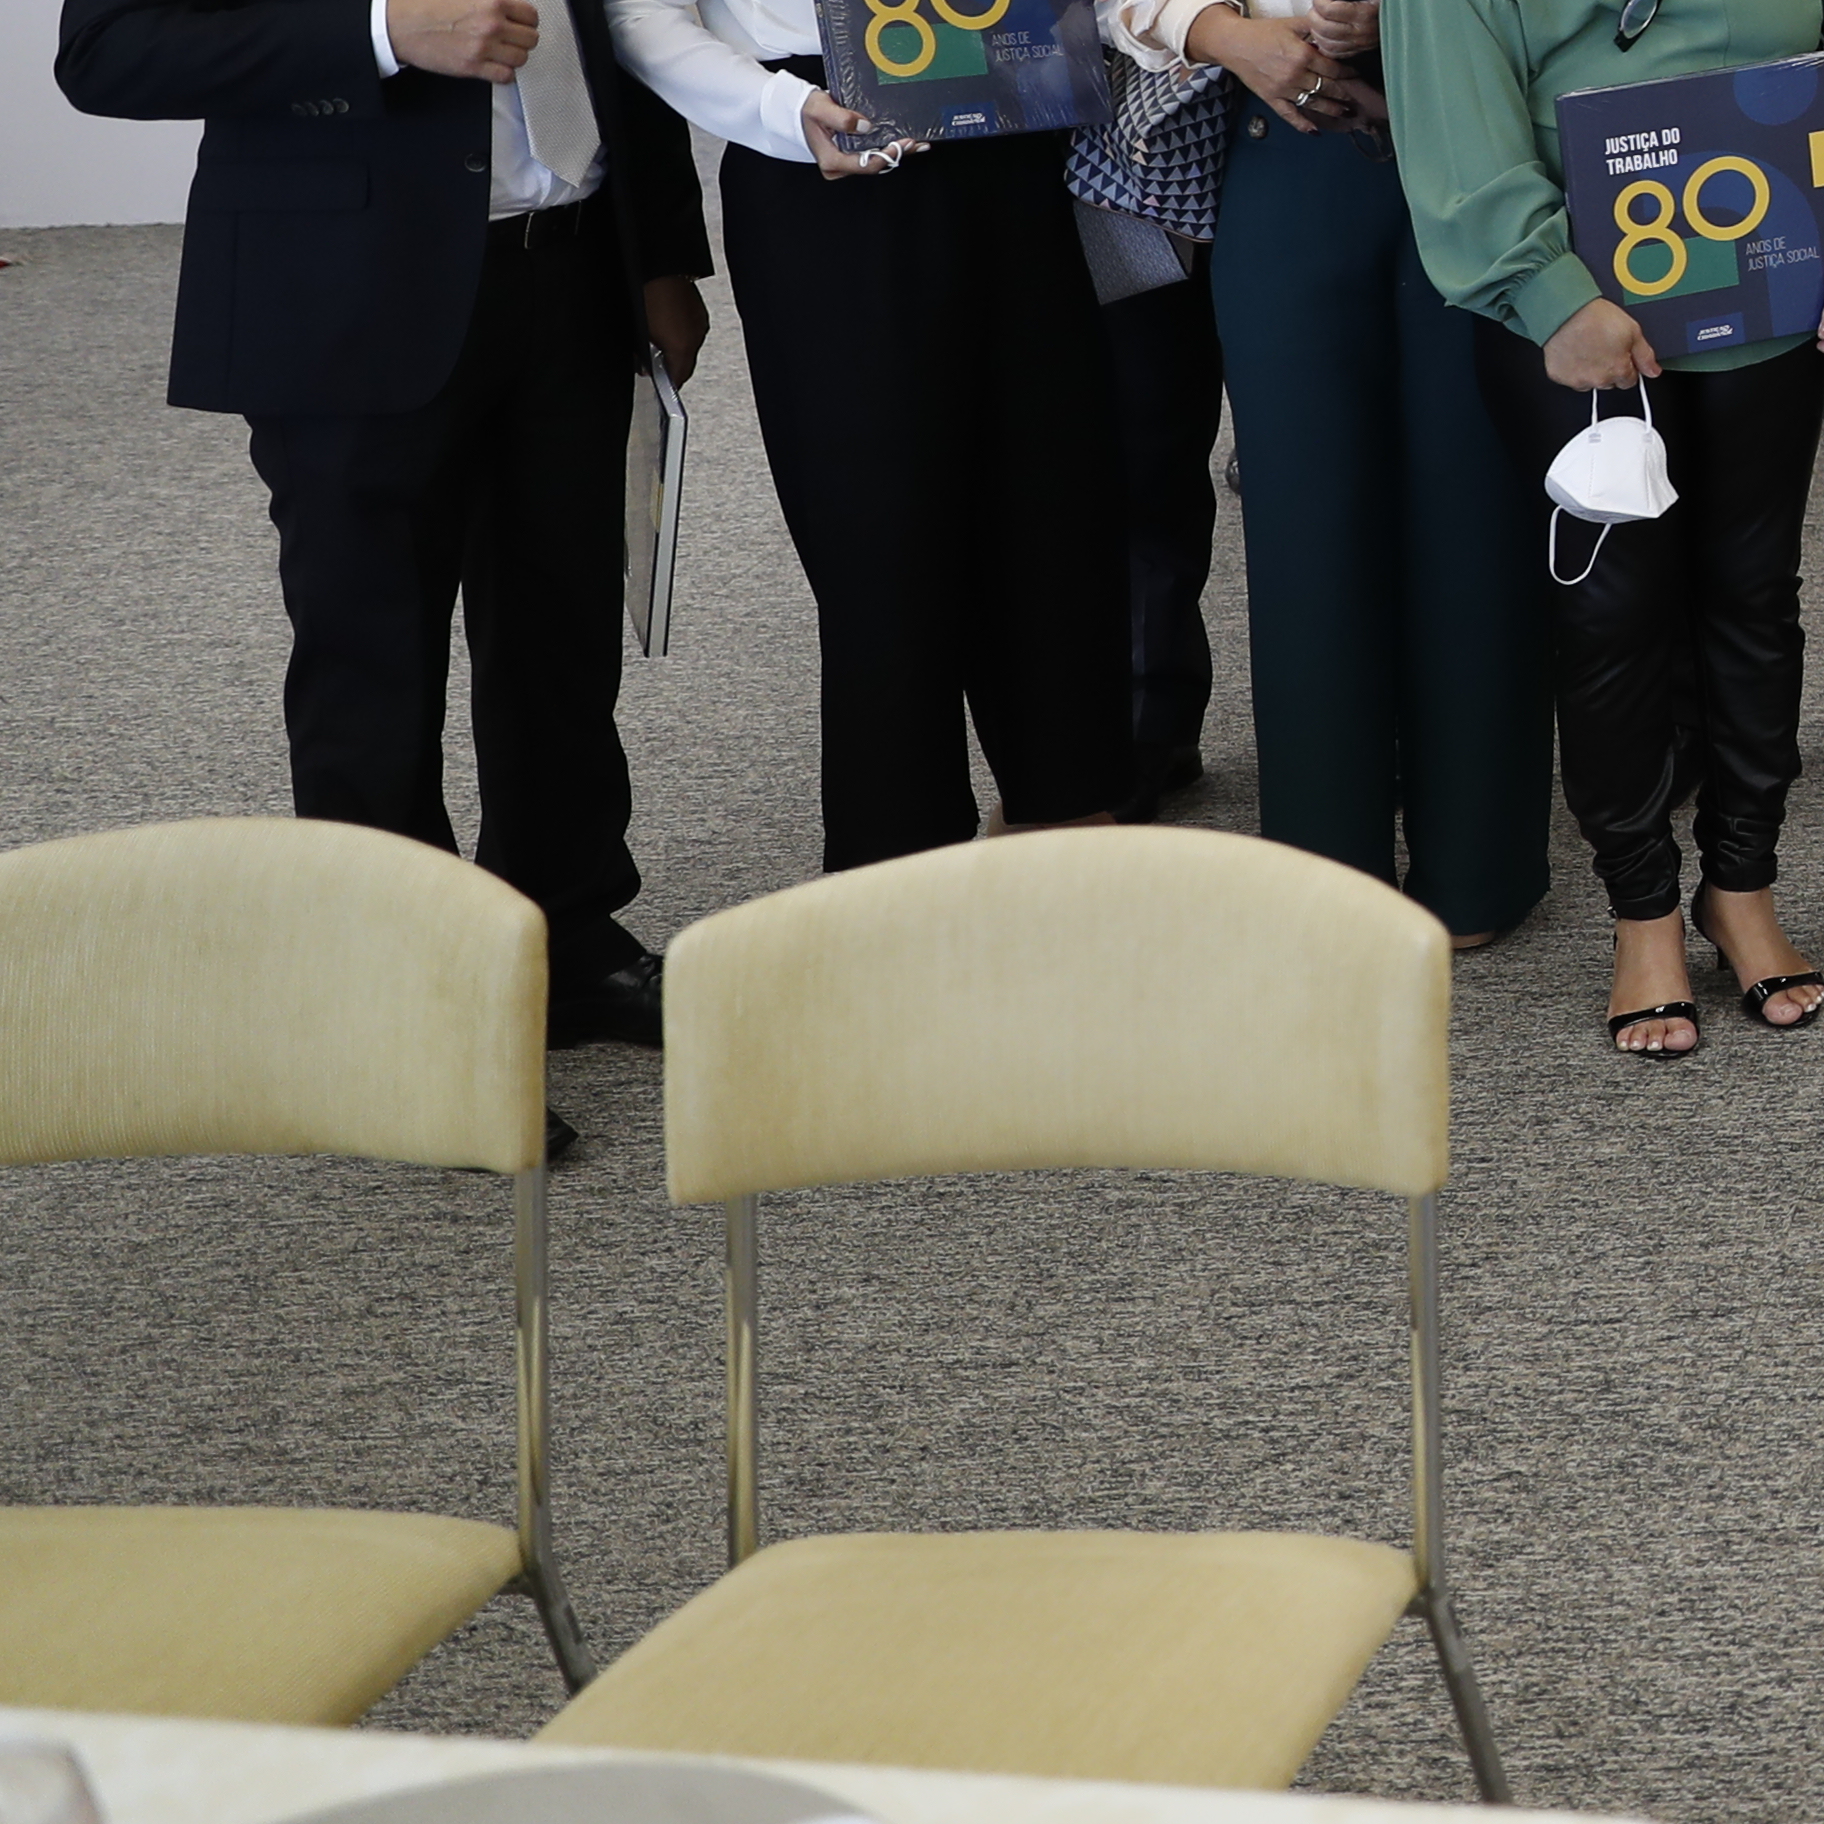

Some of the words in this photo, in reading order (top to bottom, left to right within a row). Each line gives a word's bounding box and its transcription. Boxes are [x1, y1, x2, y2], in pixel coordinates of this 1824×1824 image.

[992, 32, 1016, 46] ANOS
[1017, 31, 1032, 44] DE
[1605, 130, 1659, 155] JUSTIÇA
[1661, 127, 1681, 146] DO
[1606, 148, 1678, 175] TRABALHO
[1613, 155, 1770, 296] 80
[1745, 239, 1772, 255] ANOS
[1773, 236, 1787, 250] DE
[1748, 252, 1785, 272] JUSTIÇA
[1786, 246, 1820, 263] SOCIAL
